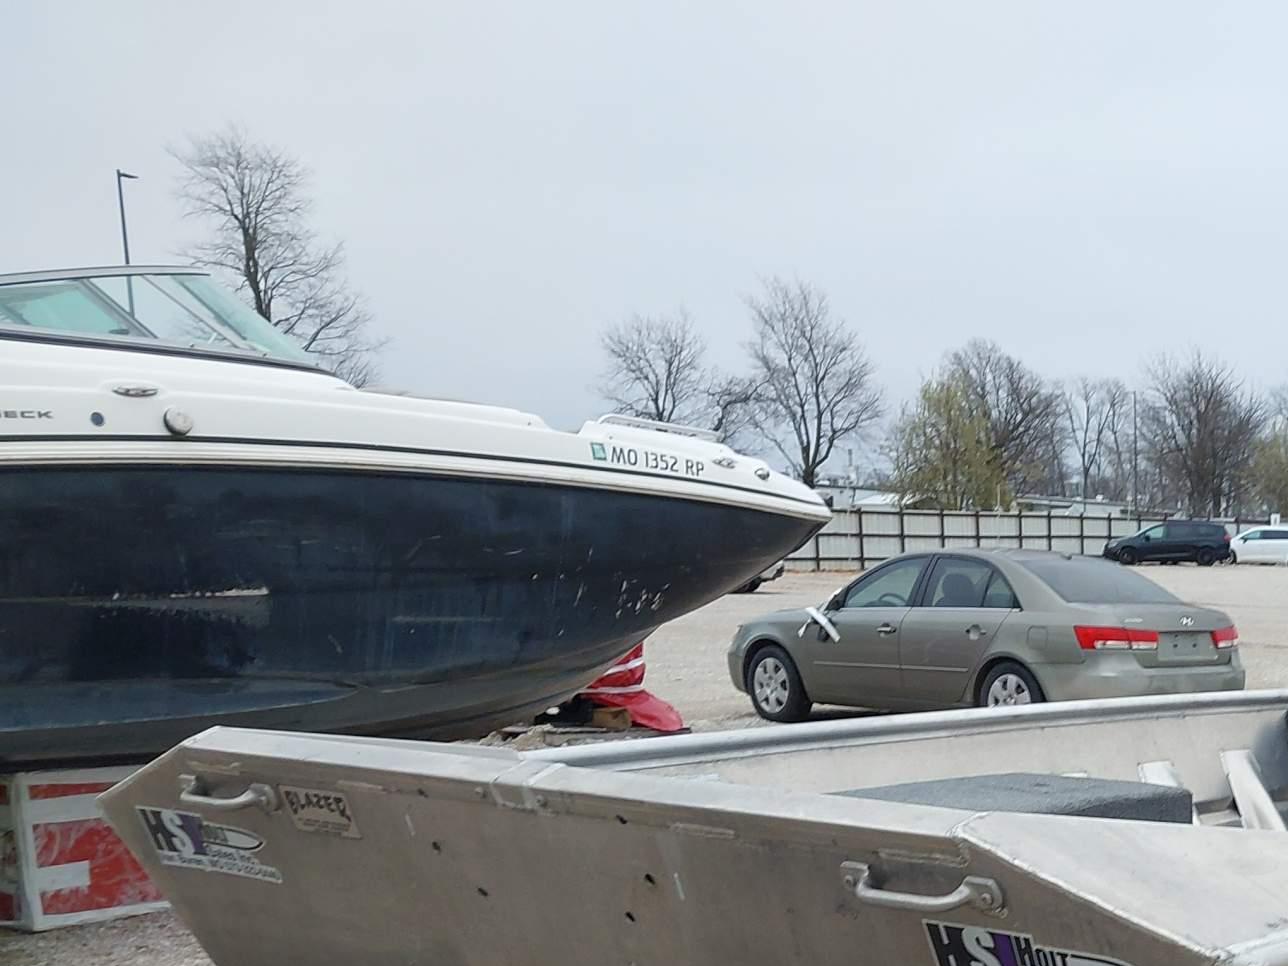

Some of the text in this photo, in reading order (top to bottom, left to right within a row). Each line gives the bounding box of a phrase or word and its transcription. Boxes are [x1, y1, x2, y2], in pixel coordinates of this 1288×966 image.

[0, 410, 53, 419] ECK
[610, 446, 705, 476] MO 1352 RP
[284, 790, 352, 823] BLAZER
